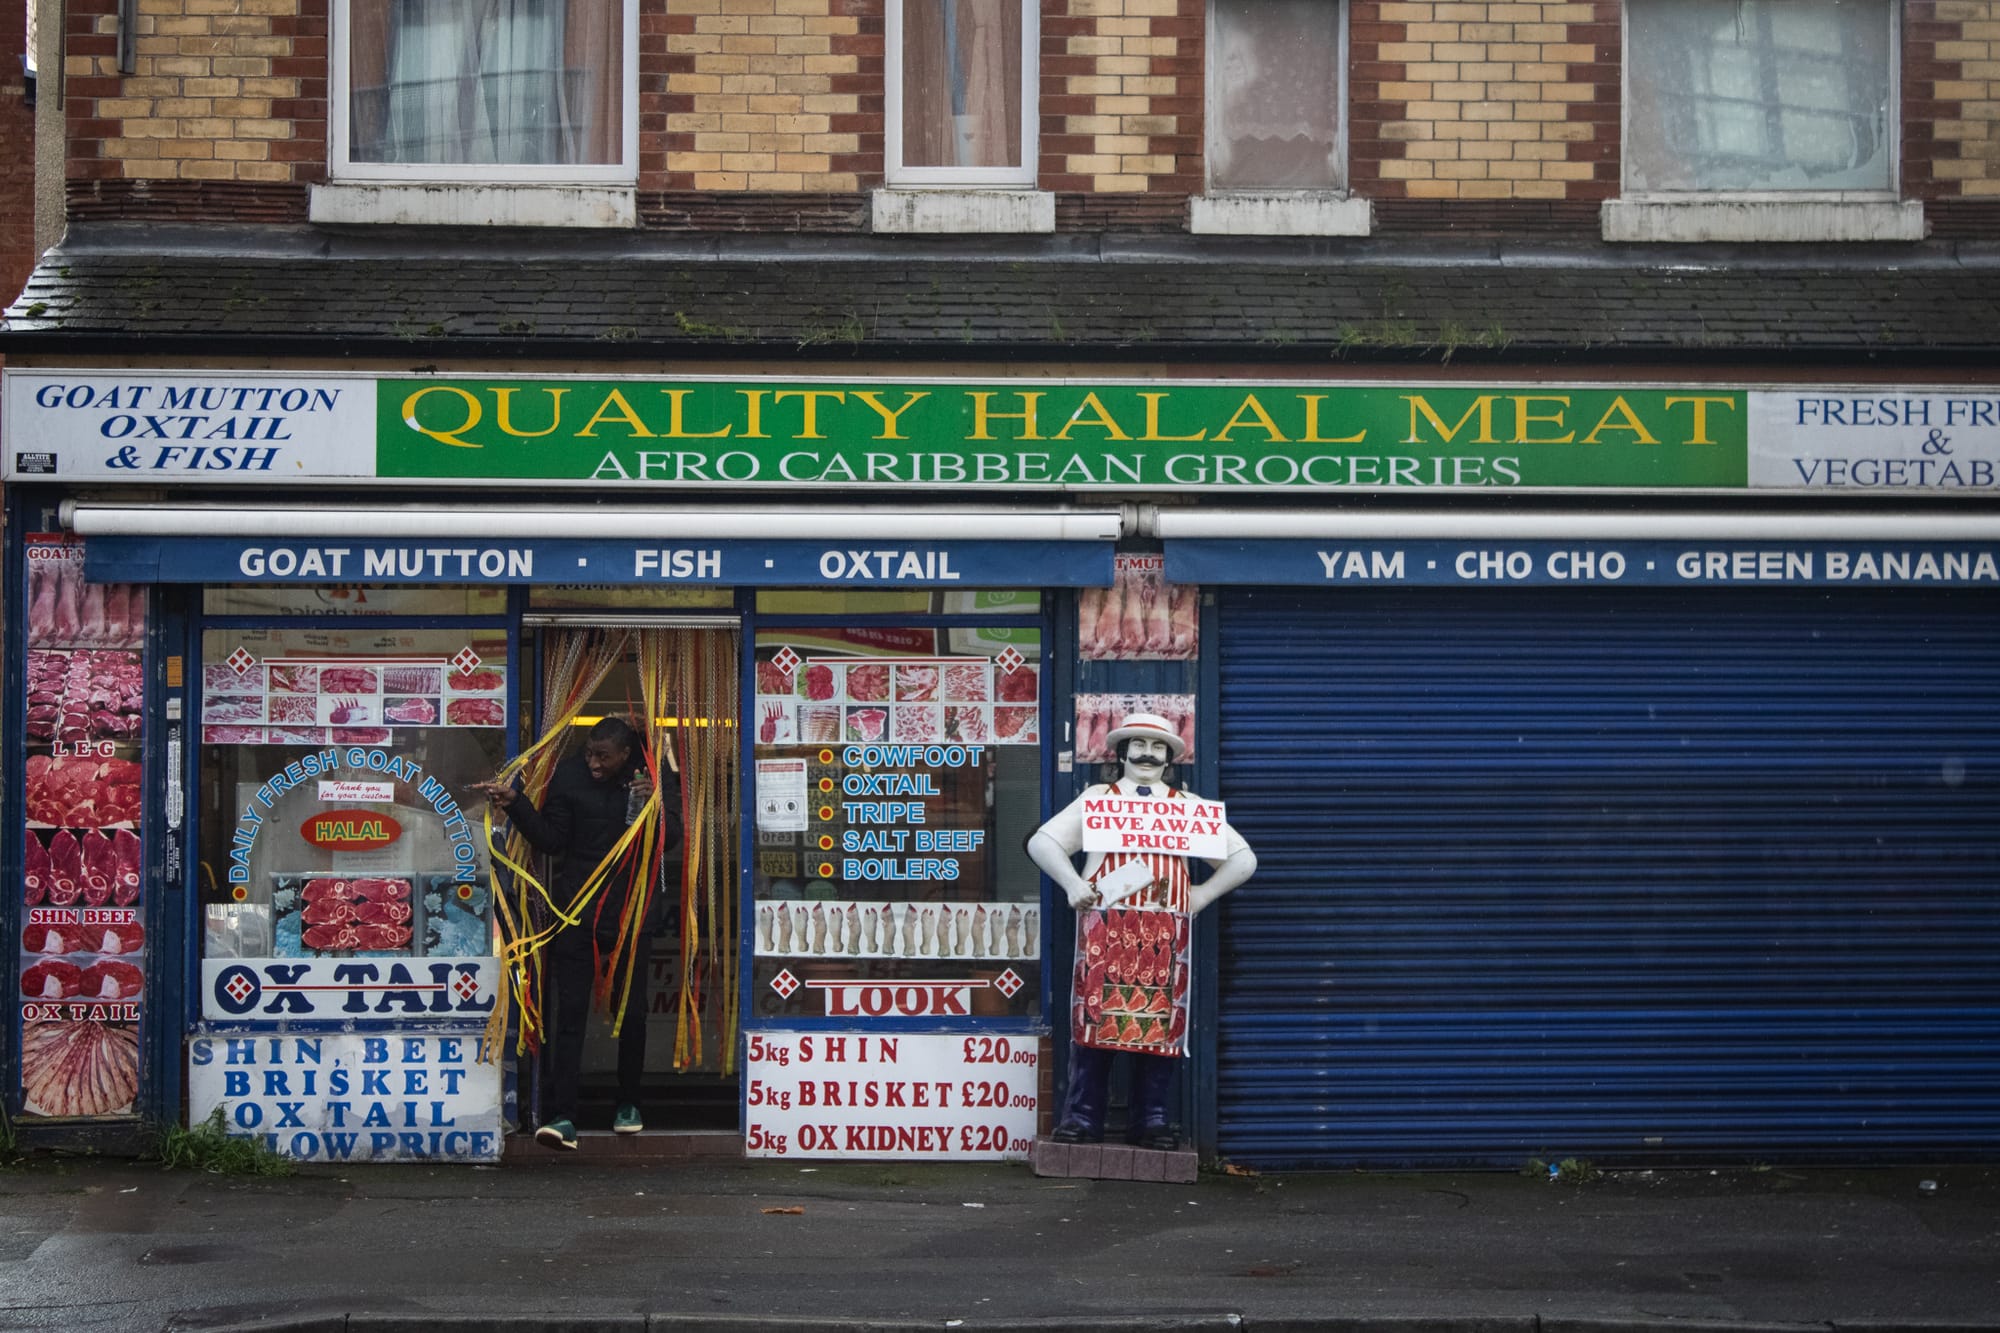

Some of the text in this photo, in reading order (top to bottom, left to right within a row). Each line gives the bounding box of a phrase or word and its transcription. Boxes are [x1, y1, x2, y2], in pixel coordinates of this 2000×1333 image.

[36, 385, 342, 412] GOAT MUTTON
[401, 386, 1735, 448] QUALITY HALAL MEAT
[1796, 398, 1931, 426] FRESH
[100, 415, 292, 441] OXTAIL
[1921, 428, 1954, 455] &
[105, 446, 282, 471] & FISH
[589, 451, 1521, 485] AFRO CARIBBEAN GROCERIES
[1793, 458, 2000, 487] VEGETAB
[27, 547, 72, 560] GOAT
[239, 548, 960, 580] GOAT MUTTON FISH OXTAIL
[1318, 551, 1999, 579] YAM CHO CHO GREEN BANANA
[53, 741, 115, 757] LEG
[843, 745, 985, 767] COWFOOT
[320, 790, 334, 800] for
[337, 792, 357, 801] your
[333, 780, 380, 793] Thank you
[842, 773, 941, 795] OXTAIL
[228, 804, 263, 883] DAILY
[256, 749, 339, 808] FRESH
[347, 747, 422, 783] GOAT
[417, 775, 476, 882] MUTTON
[842, 802, 926, 824] TRIPE
[1085, 799, 1222, 819] MUTTON AT
[315, 821, 390, 841] HALAL
[1087, 816, 1221, 835] GIVE AWAY
[843, 830, 985, 852] SALT BEEF
[1122, 833, 1190, 850] PRICE
[843, 858, 960, 881] BOILERS
[30, 909, 137, 925] SHIN BEEF
[215, 962, 496, 1014] OX TAIL
[22, 1004, 141, 1020] OX TAIL
[829, 987, 967, 1016] LOOK
[749, 1035, 1037, 1067] 5kg SHIN £20.00p
[223, 1068, 467, 1098] BRISKET
[749, 1080, 1036, 1111] 5kg BRISKET £20.00p
[234, 1100, 456, 1131] OX TAIL
[265, 1130, 496, 1161] LOW PRICE
[748, 1124, 787, 1154] 5kg
[797, 1124, 838, 1151] OX
[845, 1125, 955, 1152] KIDNEY
